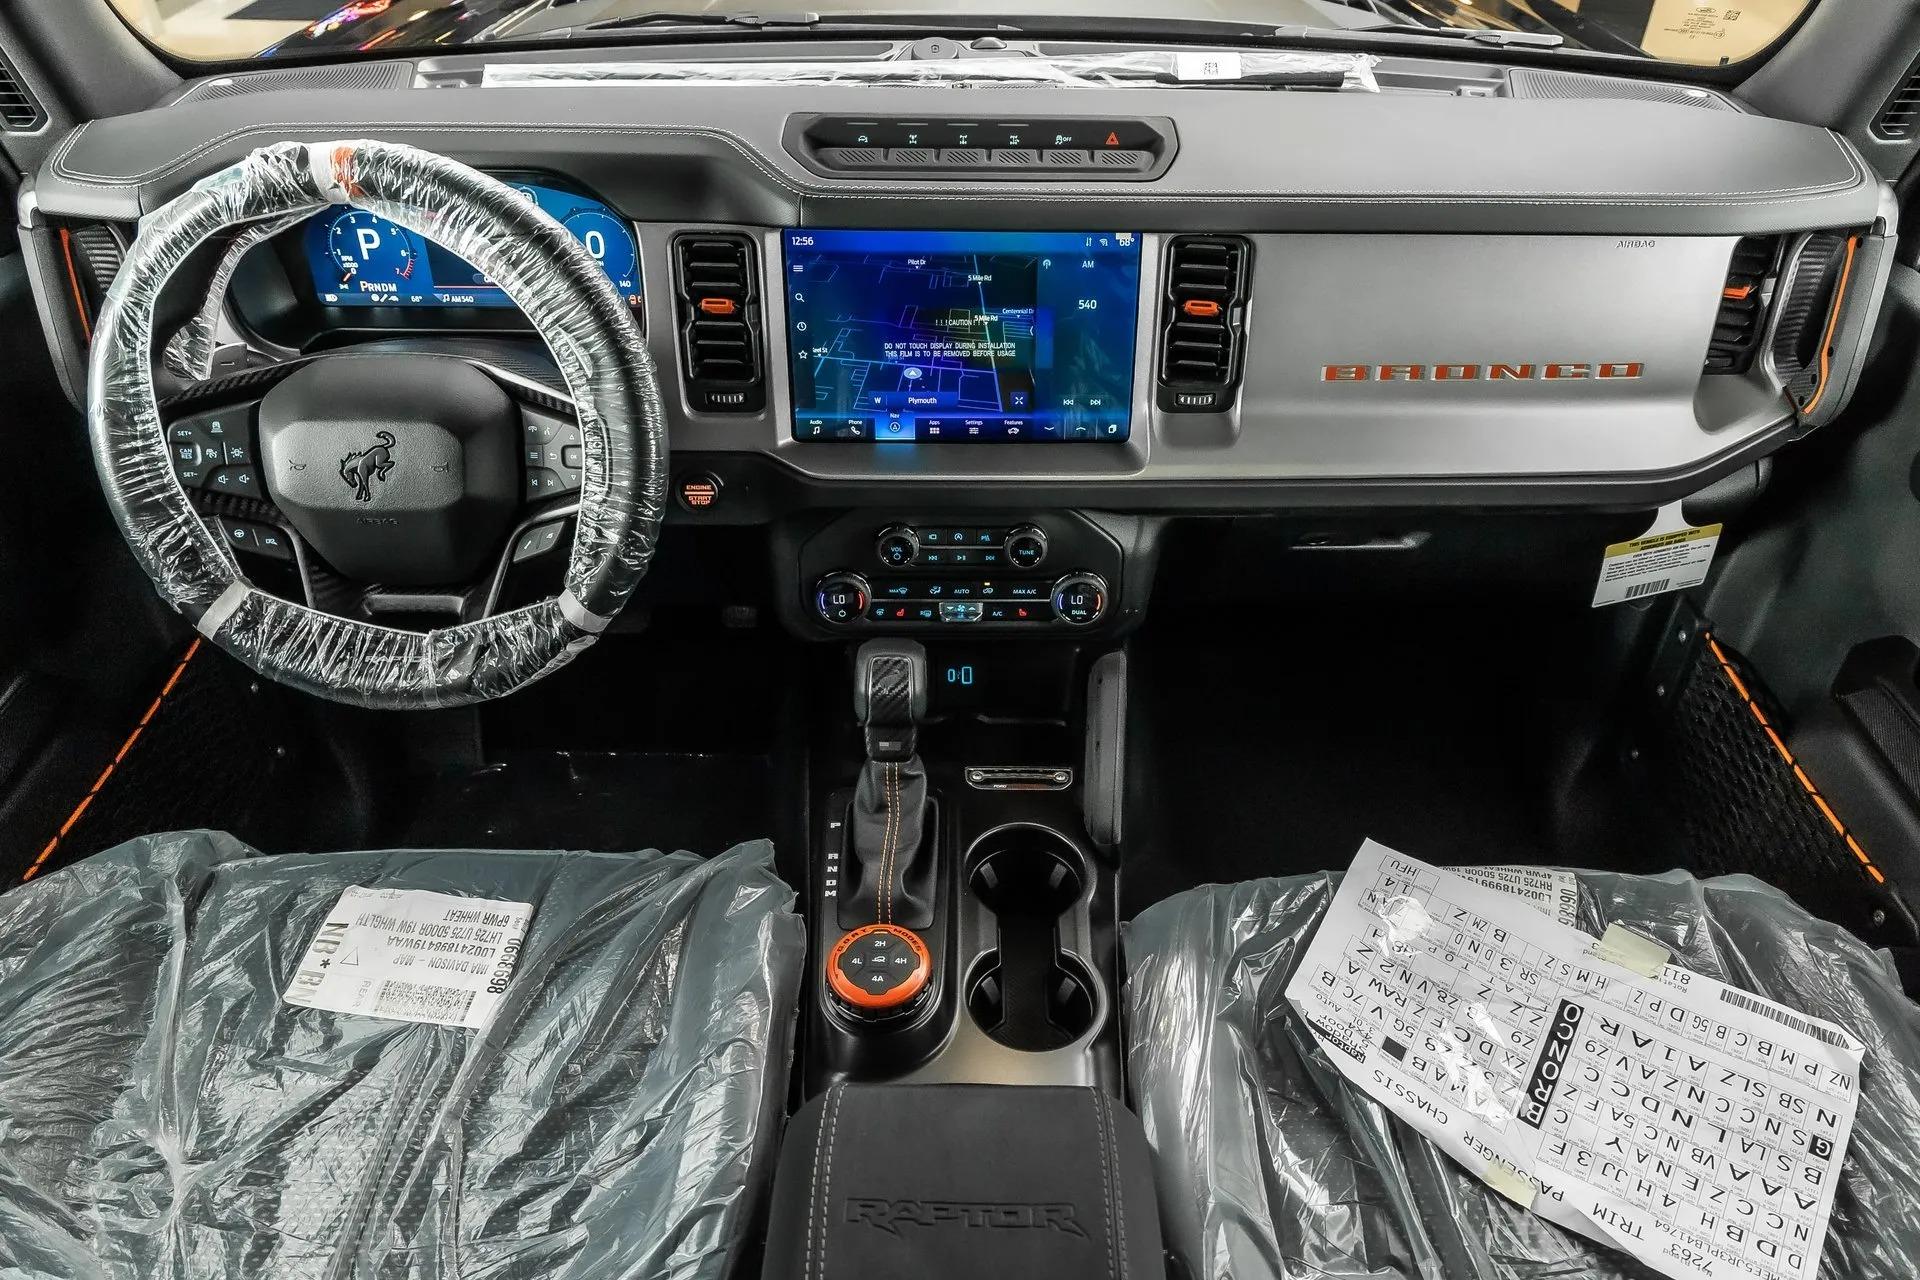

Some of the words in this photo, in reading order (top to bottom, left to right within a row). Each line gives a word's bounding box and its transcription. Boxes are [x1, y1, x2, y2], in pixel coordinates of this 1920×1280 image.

[356, 228, 380, 260] P
[585, 230, 605, 259] 0
[792, 236, 814, 246] 12:56
[1082, 260, 1095, 268] AM
[1078, 299, 1097, 310] 540
[1320, 362, 1645, 382] BRONCO
[908, 396, 938, 405] Plymouth
[832, 594, 846, 605] LO
[1071, 595, 1084, 605] LO
[1390, 860, 1416, 876] HFU
[1523, 877, 1552, 891] RH725
[1471, 916, 1487, 932] ZM
[893, 928, 921, 952] MODES
[1519, 967, 1538, 984] SR
[1342, 985, 1363, 1005] 7C
[1368, 977, 1406, 1007] RAW
[1437, 989, 1458, 1009] Z8
[1315, 993, 1341, 1012] Auto
[1320, 1014, 1353, 1037] Door
[1393, 1017, 1415, 1038] 5G
[1692, 1015, 1708, 1032] 5G
[1325, 1034, 1366, 1064] Raptor
[1510, 1030, 1534, 1050] Z9
[1584, 1039, 1608, 1059] Z9
[1503, 1051, 1527, 1073] ZX
[1525, 1003, 1582, 1124] BRONCO
[1720, 1068, 1766, 1097] SLZ
[1829, 1070, 1850, 1089] NZ
[1372, 1069, 1447, 1124] CHASSIS
[1778, 1092, 1805, 1113] SB
[1611, 1106, 1634, 1128] 5A
[1548, 1142, 1566, 1155] F
[1741, 1137, 1766, 1160] LA
[1815, 1138, 1830, 1155] G
[1463, 1129, 1564, 1202] PASSENGER
[1577, 1150, 1591, 1166] 3
[1691, 1147, 1714, 1169] VB
[1601, 1162, 1628, 1182] JJ
[1636, 1178, 1651, 1196] H
[1661, 1193, 1676, 1207] 4
[843, 1197, 1091, 1240] RAPTOR
[1592, 1202, 1643, 1240] TRIM
[1700, 1212, 1714, 1228] H
[1726, 1224, 1743, 1242] B
[1670, 1243, 1712, 1272] 7263
[1756, 1239, 1776, 1257] D
[1788, 1253, 1801, 1269] D
